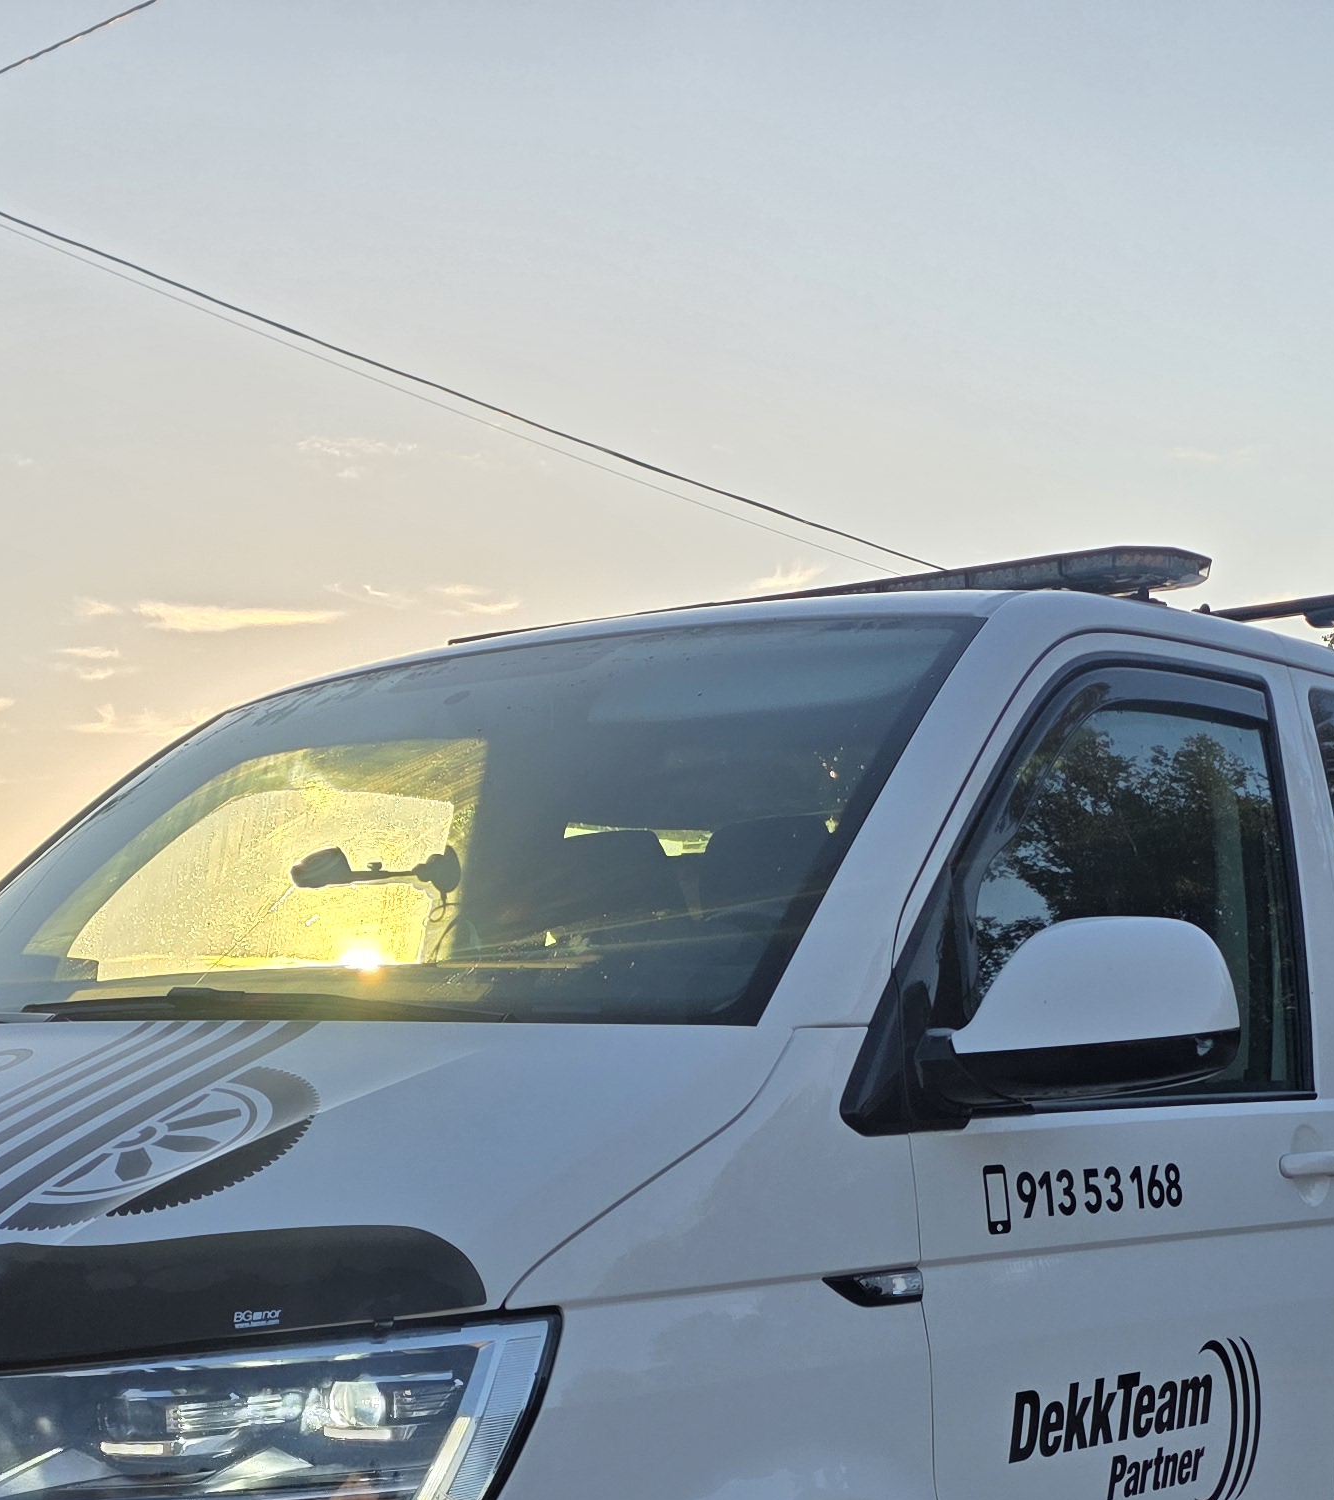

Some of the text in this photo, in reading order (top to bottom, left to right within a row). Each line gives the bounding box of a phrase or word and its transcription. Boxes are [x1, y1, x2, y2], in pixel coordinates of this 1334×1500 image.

[1016, 1163, 1183, 1218] 913 53 168
[1008, 1371, 1213, 1464] DekkTeam
[1106, 1446, 1206, 1500] Partner
